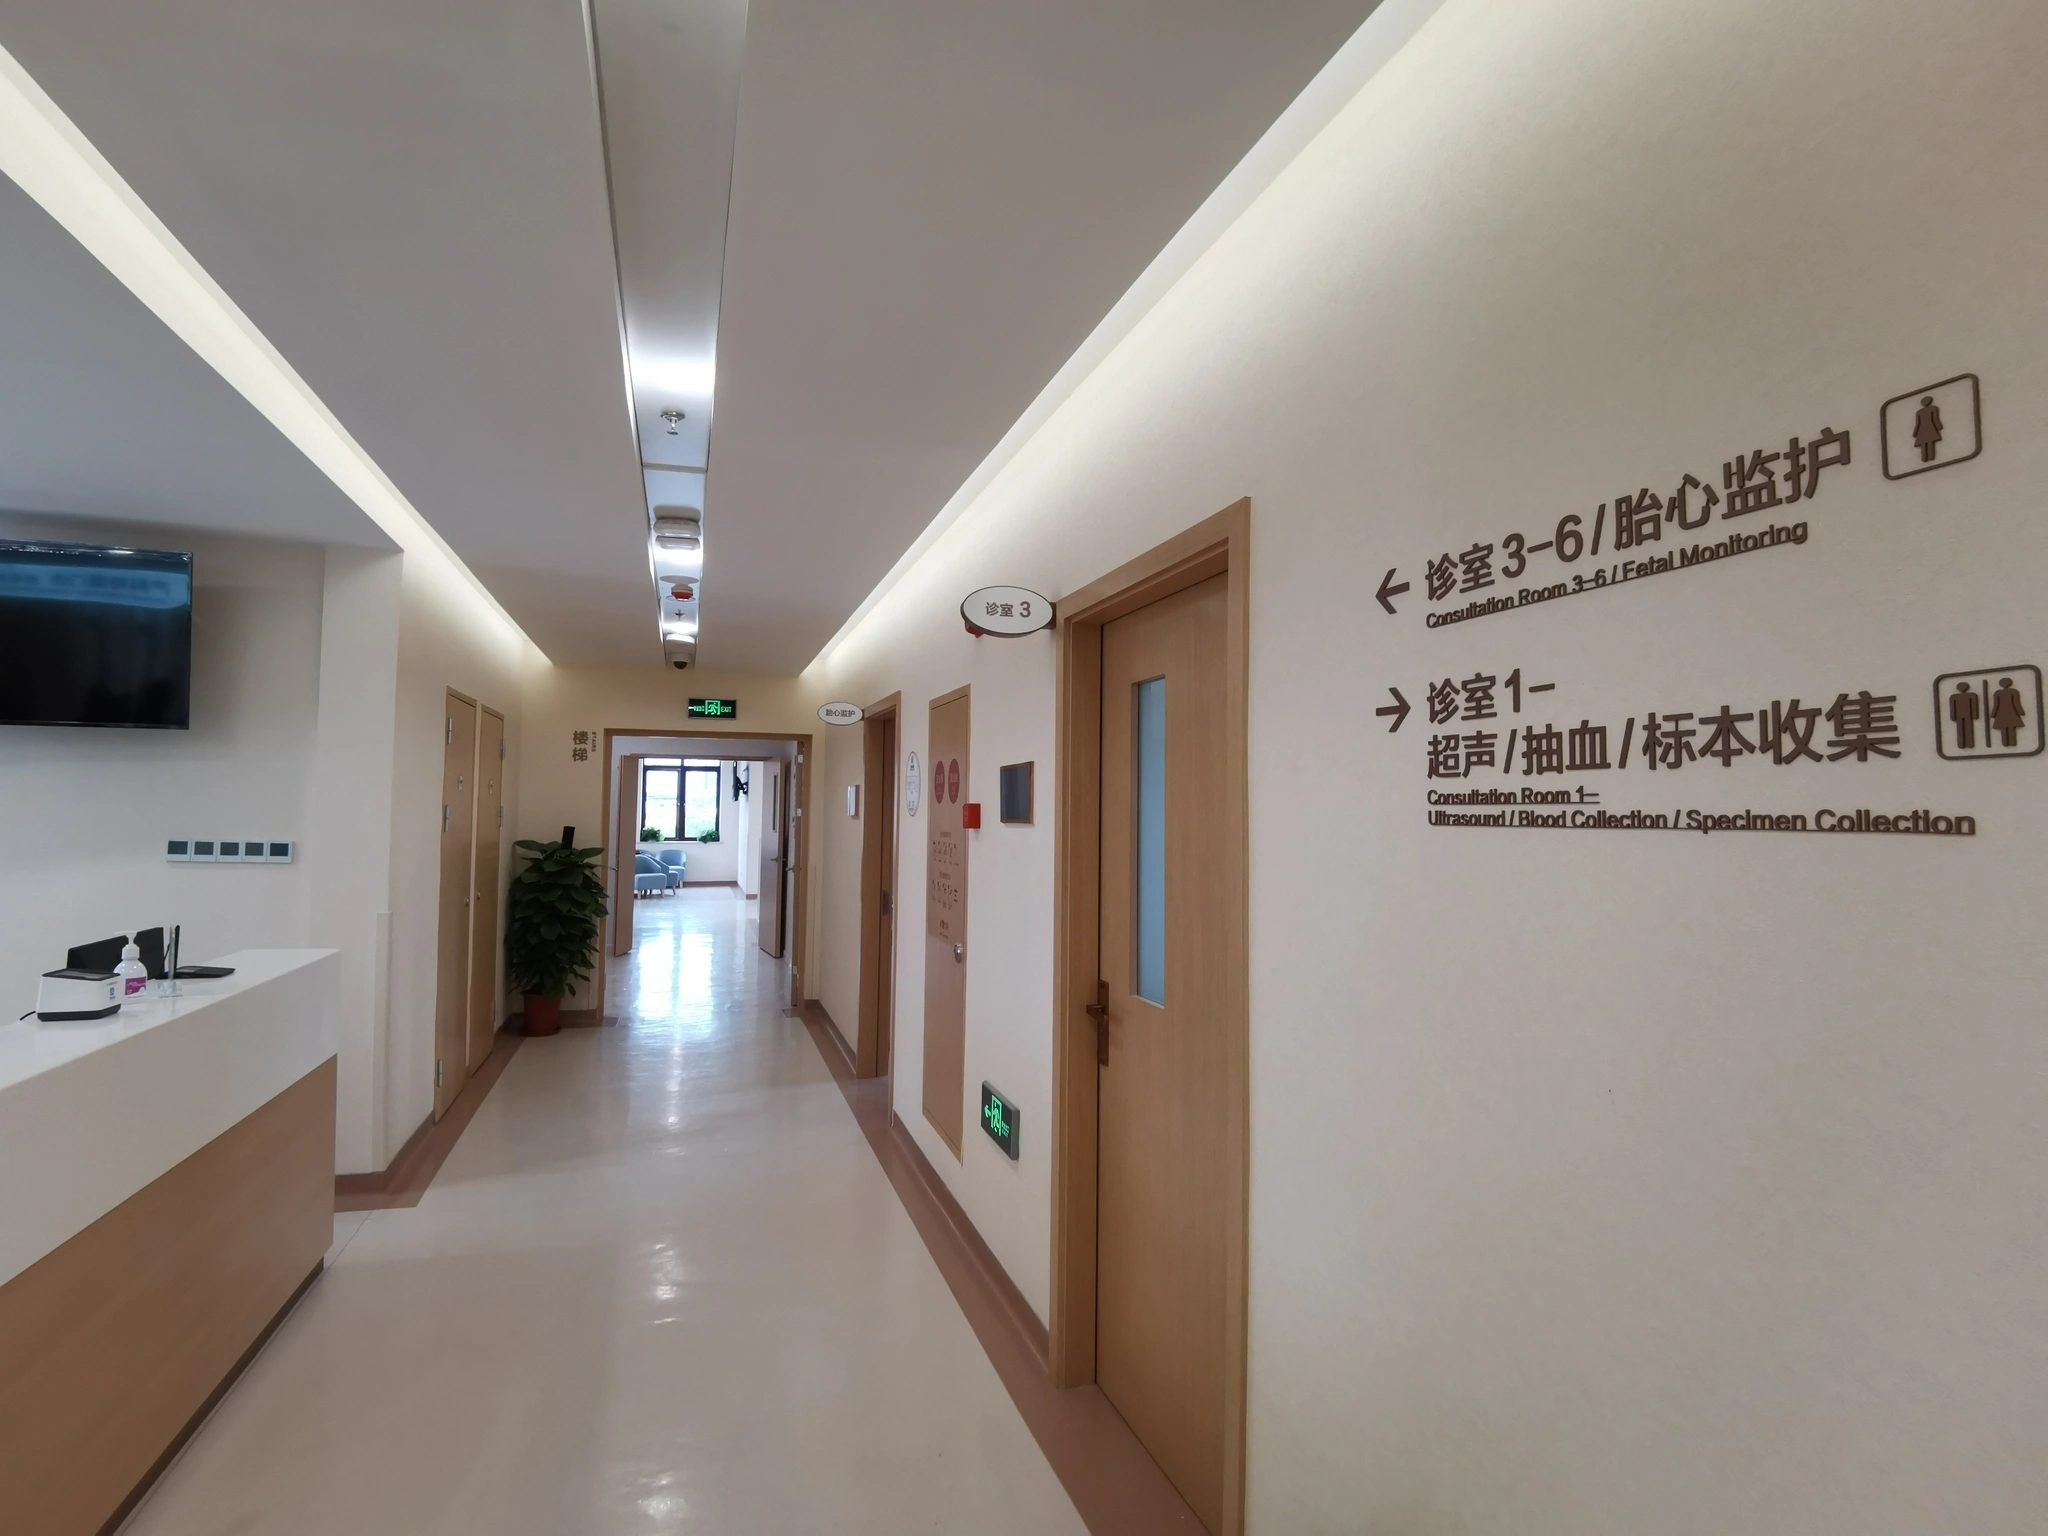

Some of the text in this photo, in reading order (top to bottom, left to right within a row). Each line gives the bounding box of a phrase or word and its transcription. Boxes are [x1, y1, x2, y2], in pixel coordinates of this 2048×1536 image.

[1426, 596, 1515, 628] Consultation
[1518, 582, 1568, 607] Room
[1622, 551, 1674, 580] Fetal
[1680, 521, 1808, 567] Monitoring
[985, 600, 1032, 618] 诊室 3
[825, 708, 856, 718] 胎心监护
[572, 730, 589, 763] 楼梯
[1427, 789, 1517, 805] Consultation
[1521, 787, 1571, 804] Room
[1428, 810, 1506, 826] Ultrasound
[1518, 810, 1567, 827] Blood
[1571, 809, 1667, 829] Collection
[1685, 809, 1807, 834] Specimen
[1814, 809, 1976, 835] Collection
